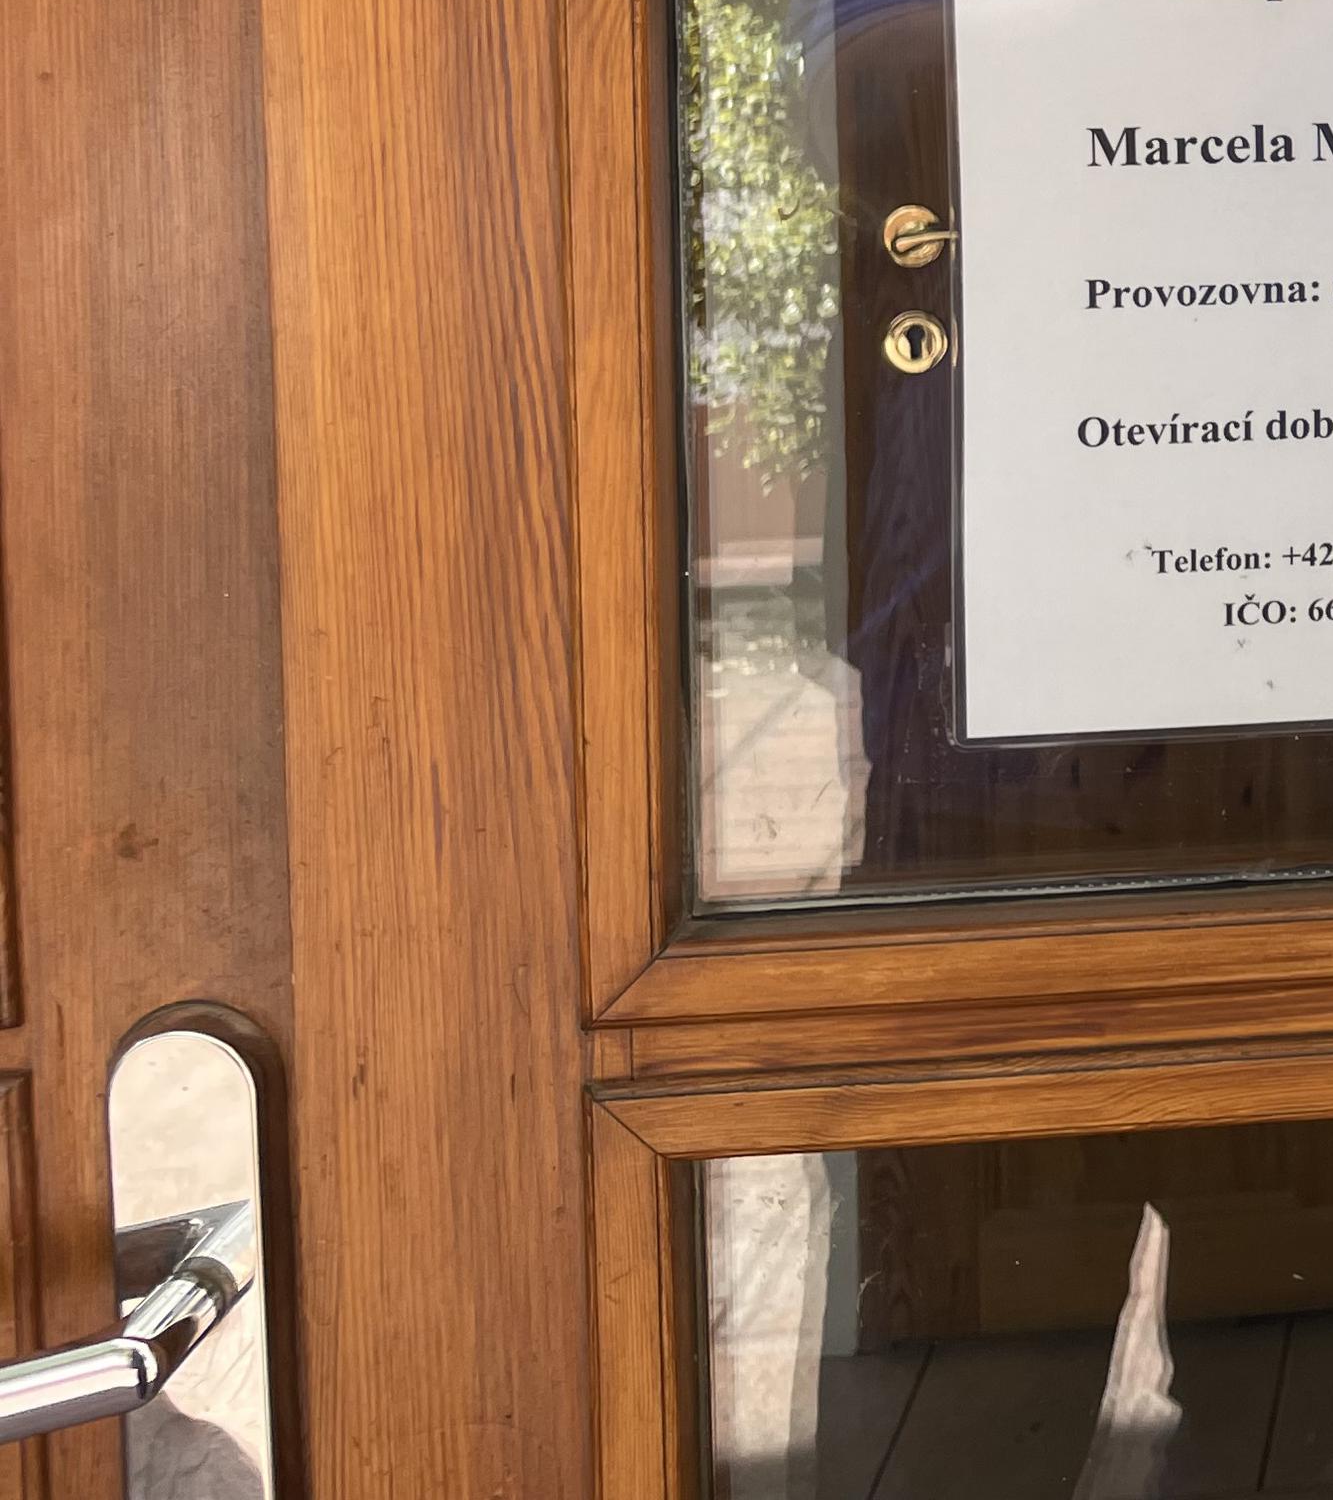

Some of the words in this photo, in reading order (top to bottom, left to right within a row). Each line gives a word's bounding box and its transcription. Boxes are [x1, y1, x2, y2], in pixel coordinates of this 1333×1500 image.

[1086, 124, 1296, 167] Marcela
[1085, 279, 1320, 310] Provozovna:
[1077, 410, 1254, 448] Otevírací
[1151, 546, 1271, 574] Telefon:
[1223, 593, 1297, 627] IČO:
